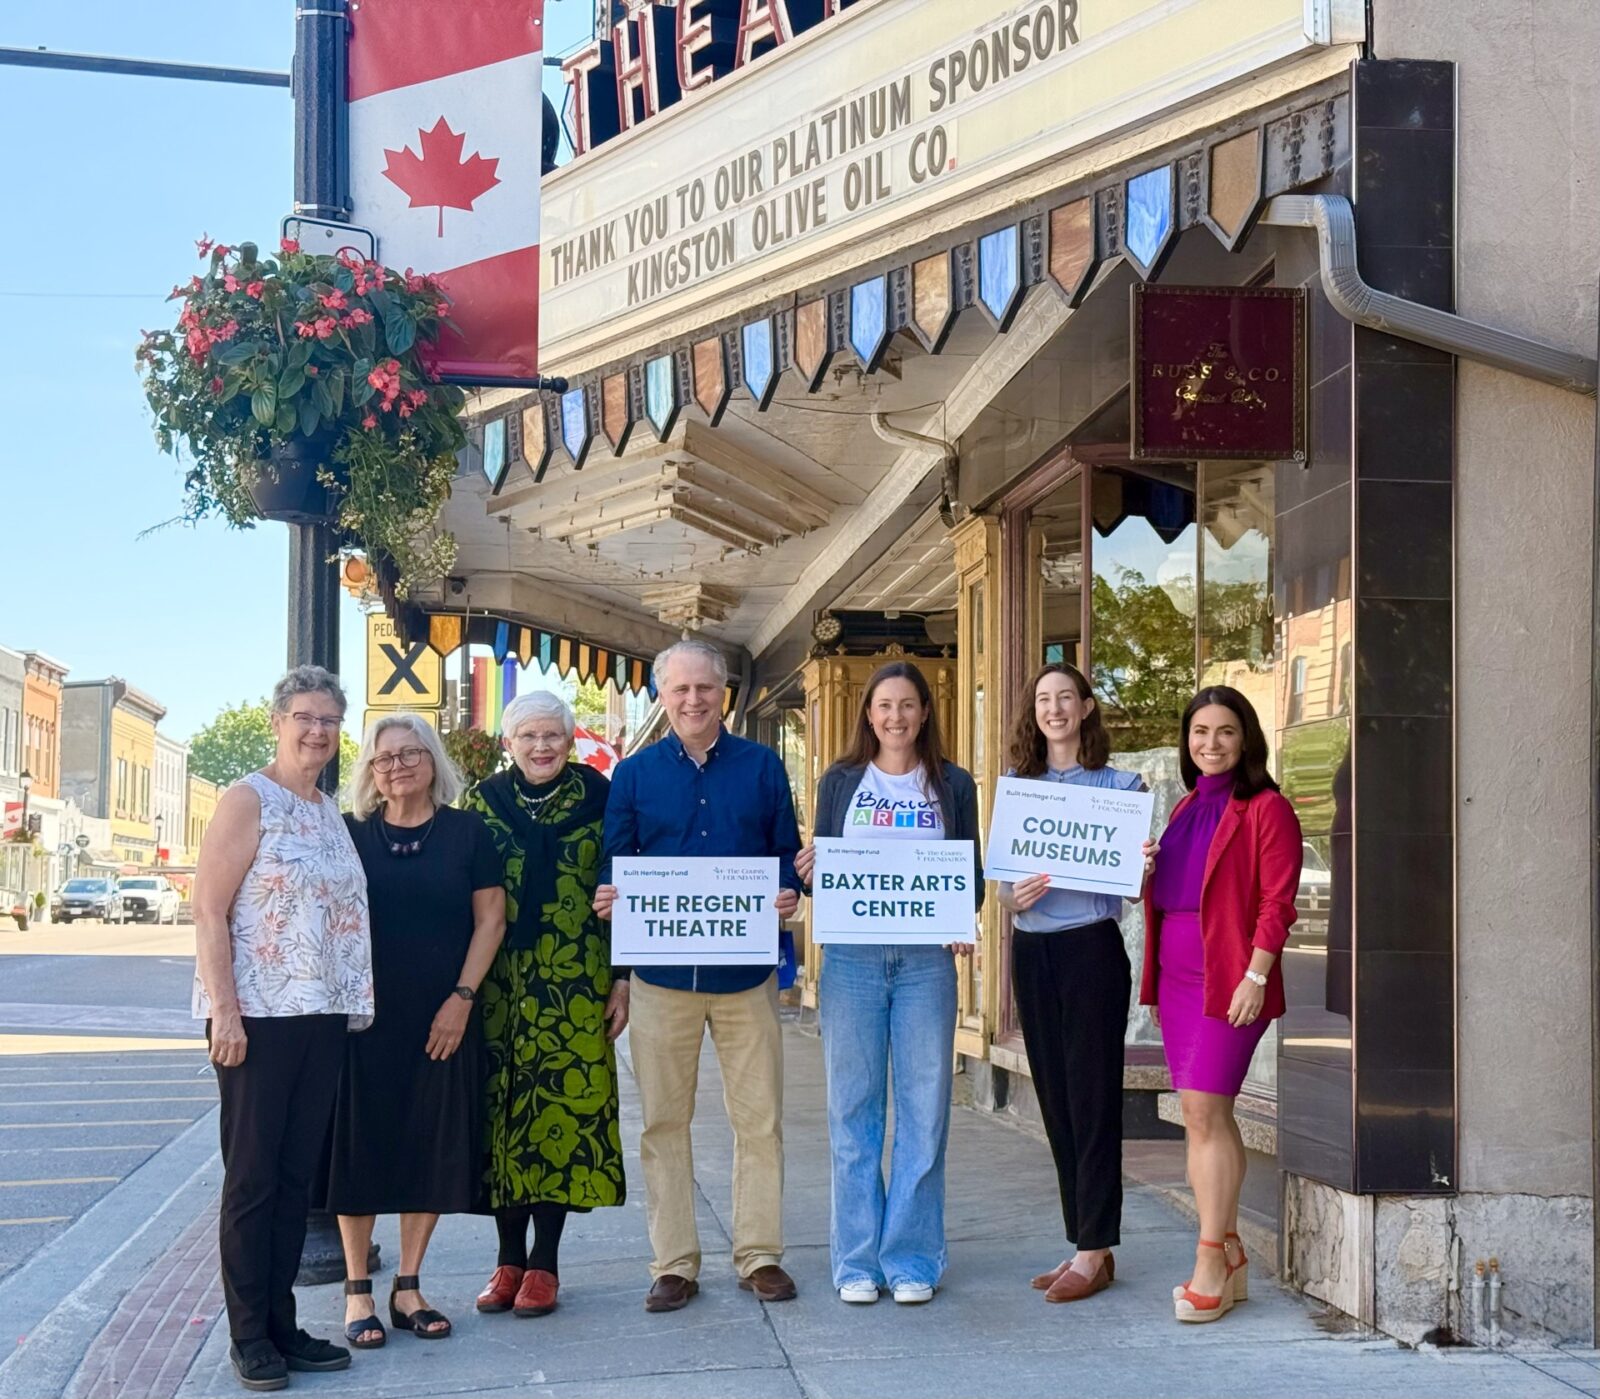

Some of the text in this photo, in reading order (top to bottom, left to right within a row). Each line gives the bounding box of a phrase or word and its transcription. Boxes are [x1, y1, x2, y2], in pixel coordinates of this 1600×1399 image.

[551, 0, 1079, 286] THANK YOU TO OUR PLATINUM SPONSOR
[628, 124, 955, 307] KINGSTON OLIVE OIL CO.
[1152, 363, 1287, 382] RUSS & CO.
[1021, 792, 1049, 801] Heritage
[854, 811, 933, 828] ARTS
[1022, 816, 1118, 843] COUNTY
[1010, 838, 1122, 868] MUSEUMS
[640, 870, 670, 878] Heritage
[821, 873, 966, 891] BAXTER ARTS
[626, 895, 766, 913] THE REGENT
[852, 900, 935, 917] CENTRE
[644, 919, 747, 937] THEATRE
